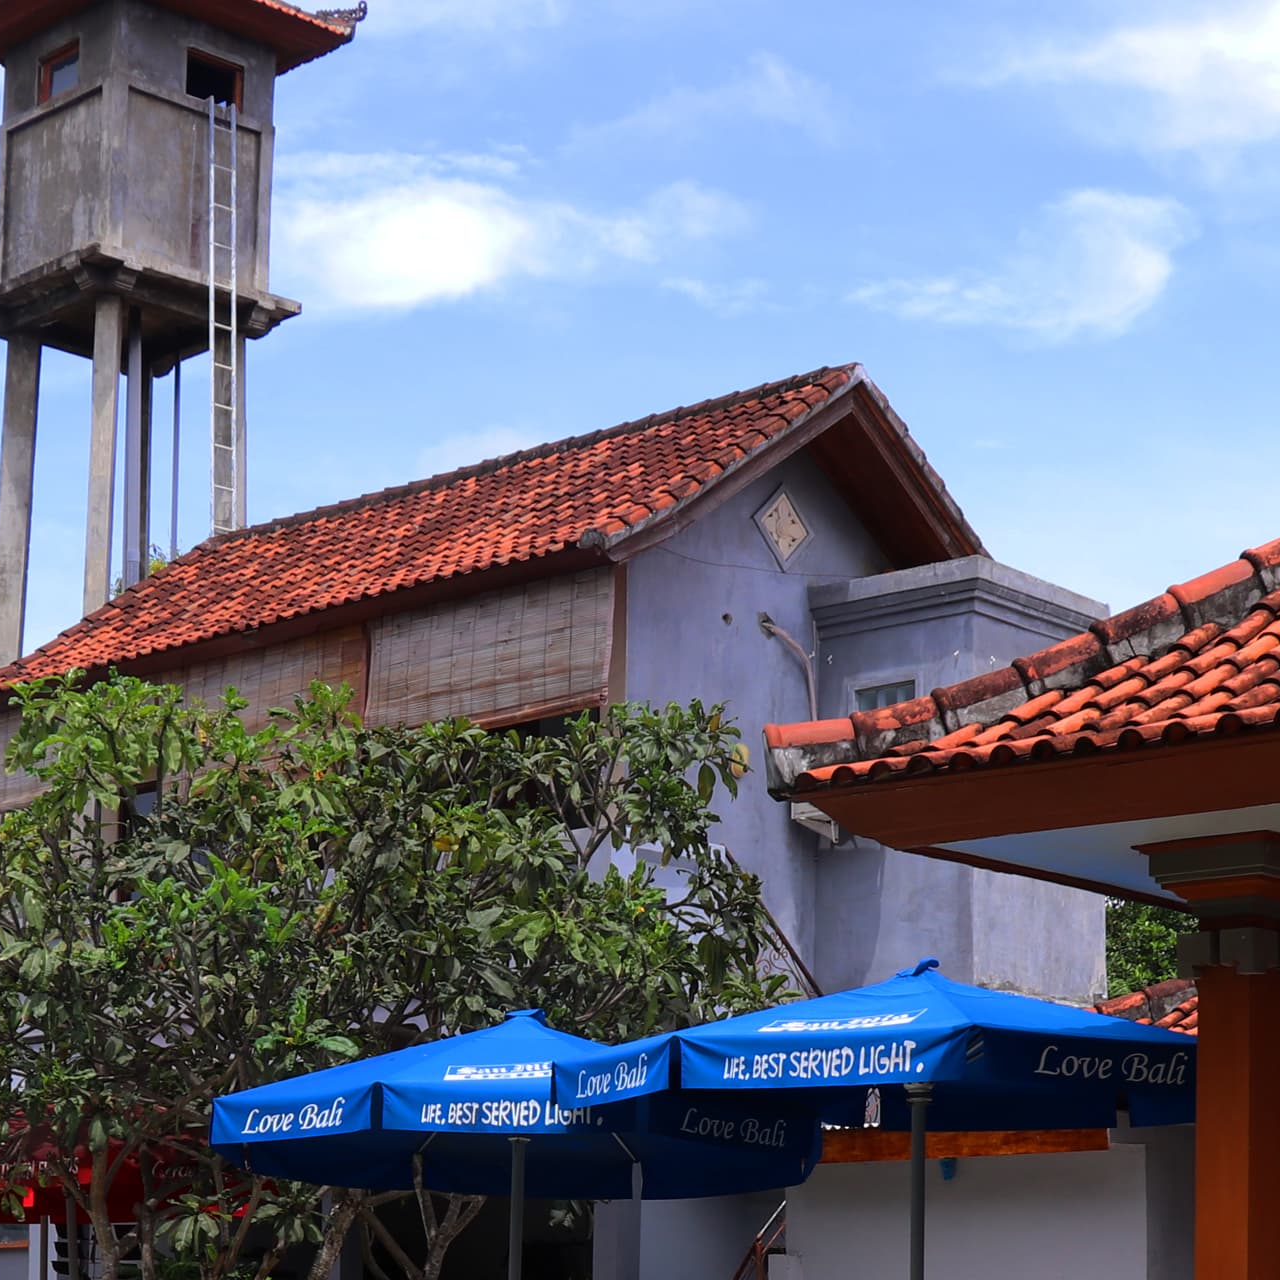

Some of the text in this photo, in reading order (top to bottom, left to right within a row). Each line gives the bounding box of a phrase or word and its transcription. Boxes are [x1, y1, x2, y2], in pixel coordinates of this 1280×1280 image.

[575, 1053, 648, 1098] Love Bali
[723, 1040, 925, 1080] LIFE, BEST SERVED LIGHT.
[1033, 1045, 1189, 1086] Love Bali
[241, 1096, 346, 1135] Love Bali
[420, 1103, 446, 1125] LIFE,
[448, 1102, 480, 1125] BEST
[481, 1099, 542, 1127] SERVED
[679, 1107, 788, 1148] Love Bali
